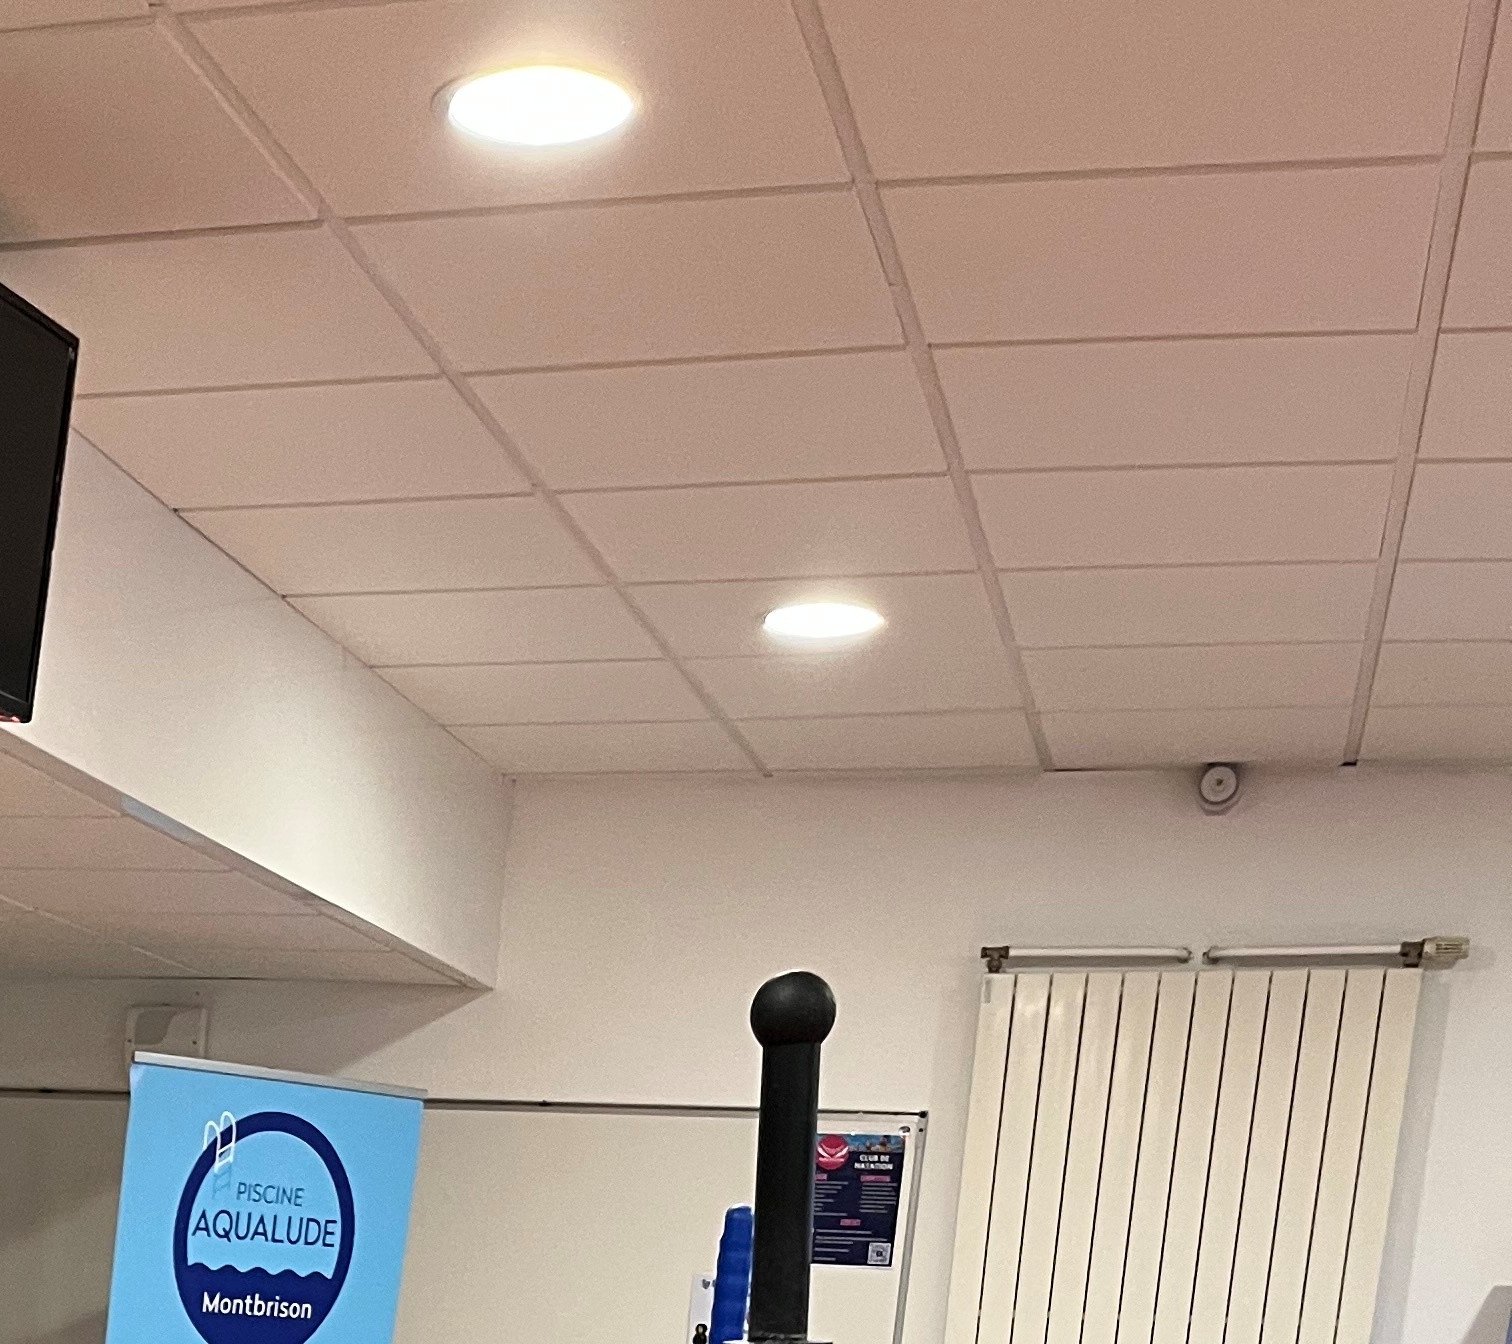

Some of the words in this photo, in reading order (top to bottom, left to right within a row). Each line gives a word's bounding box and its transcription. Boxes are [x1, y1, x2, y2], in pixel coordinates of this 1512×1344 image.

[236, 1181, 305, 1207] PISCINE
[191, 1209, 338, 1248] AQUALUDE
[202, 1291, 312, 1319] Montbrison
